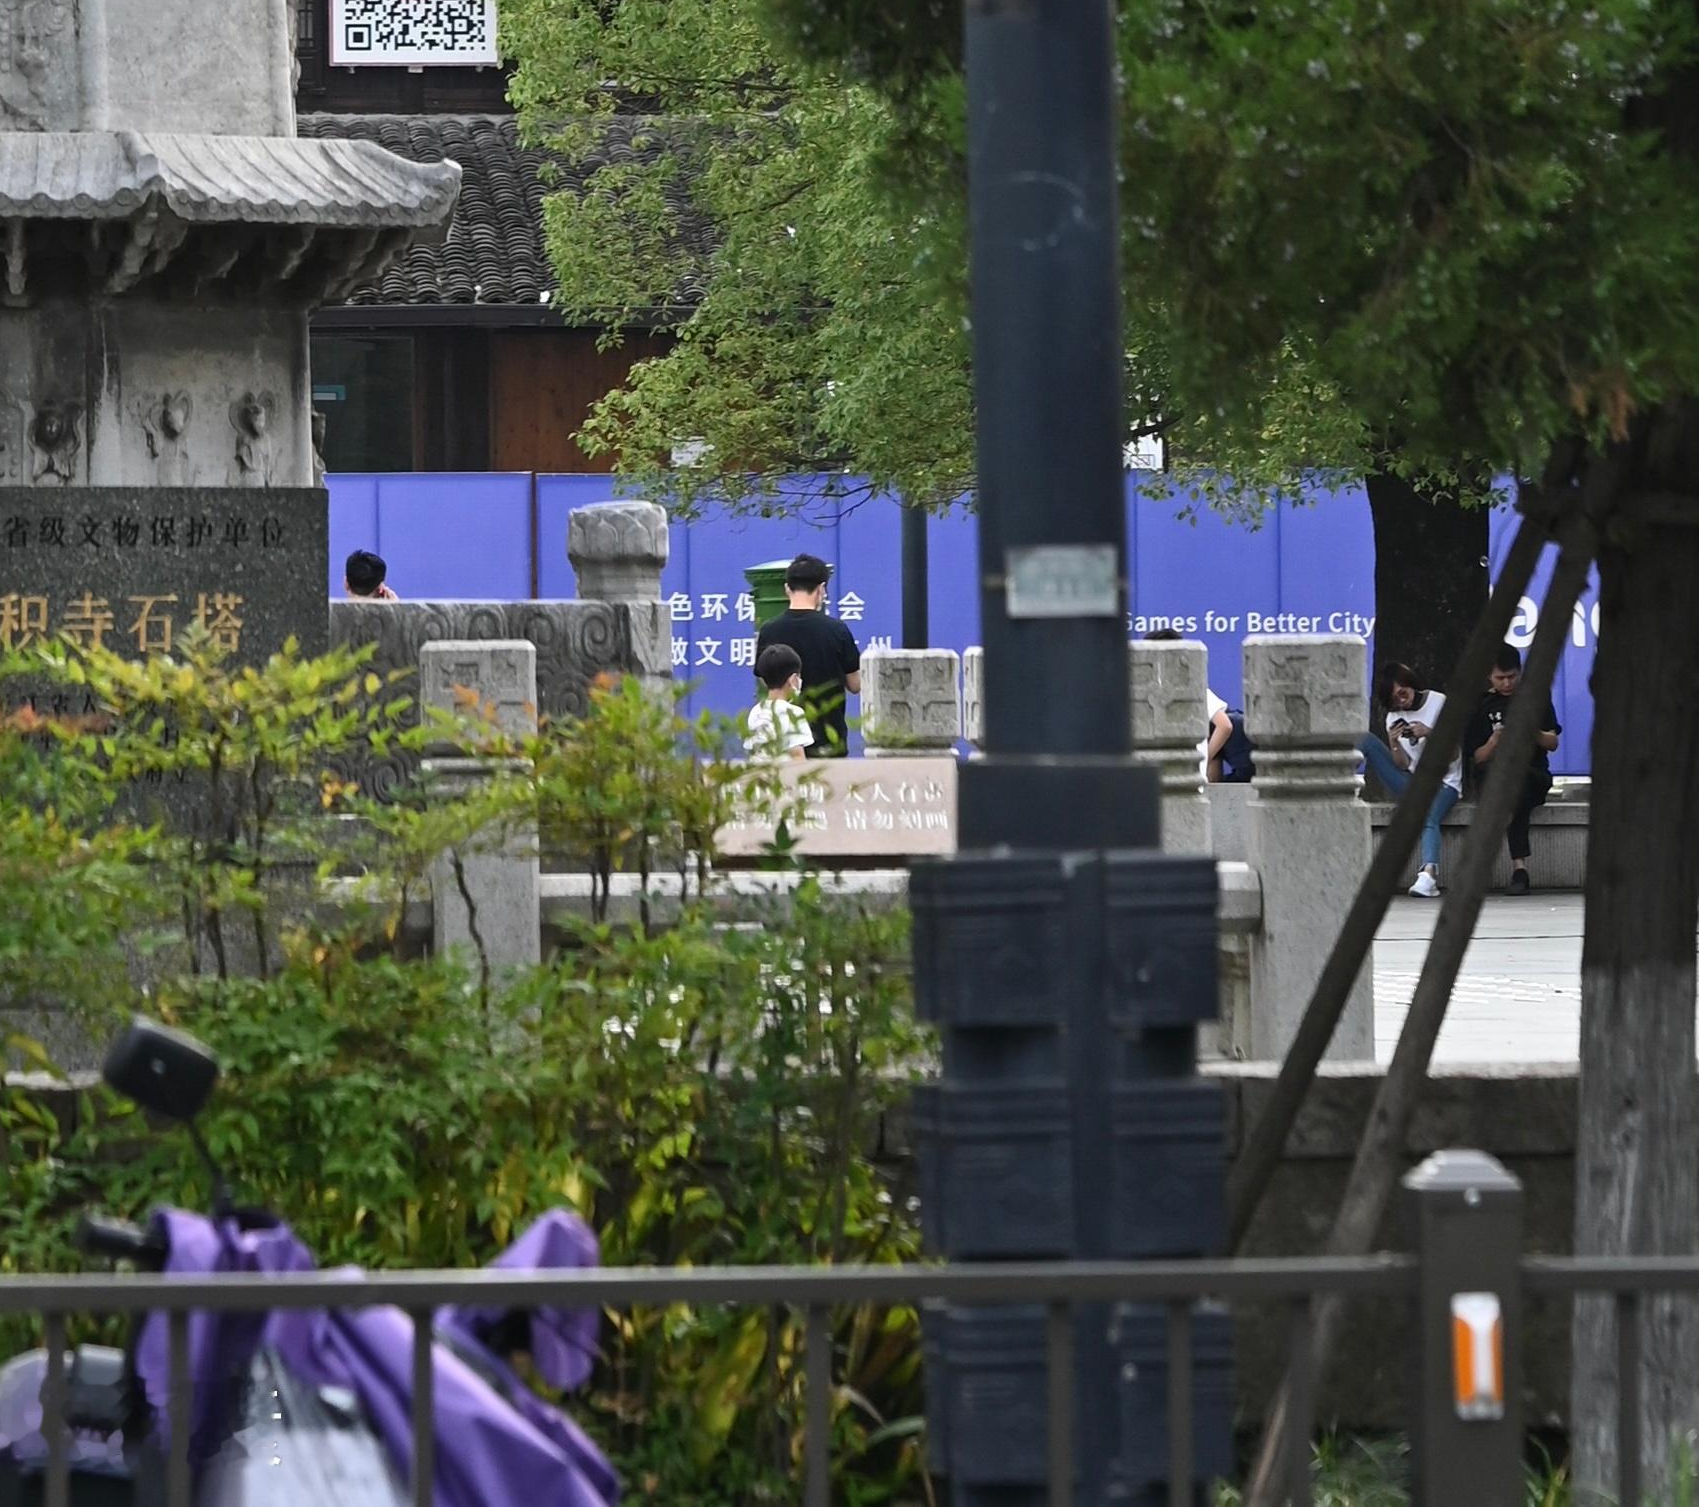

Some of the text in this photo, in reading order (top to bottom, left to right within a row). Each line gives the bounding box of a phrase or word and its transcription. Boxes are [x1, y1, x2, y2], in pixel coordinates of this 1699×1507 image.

[1204, 609, 1241, 633] for
[1247, 611, 1322, 633] Better
[1328, 610, 1376, 639] City
